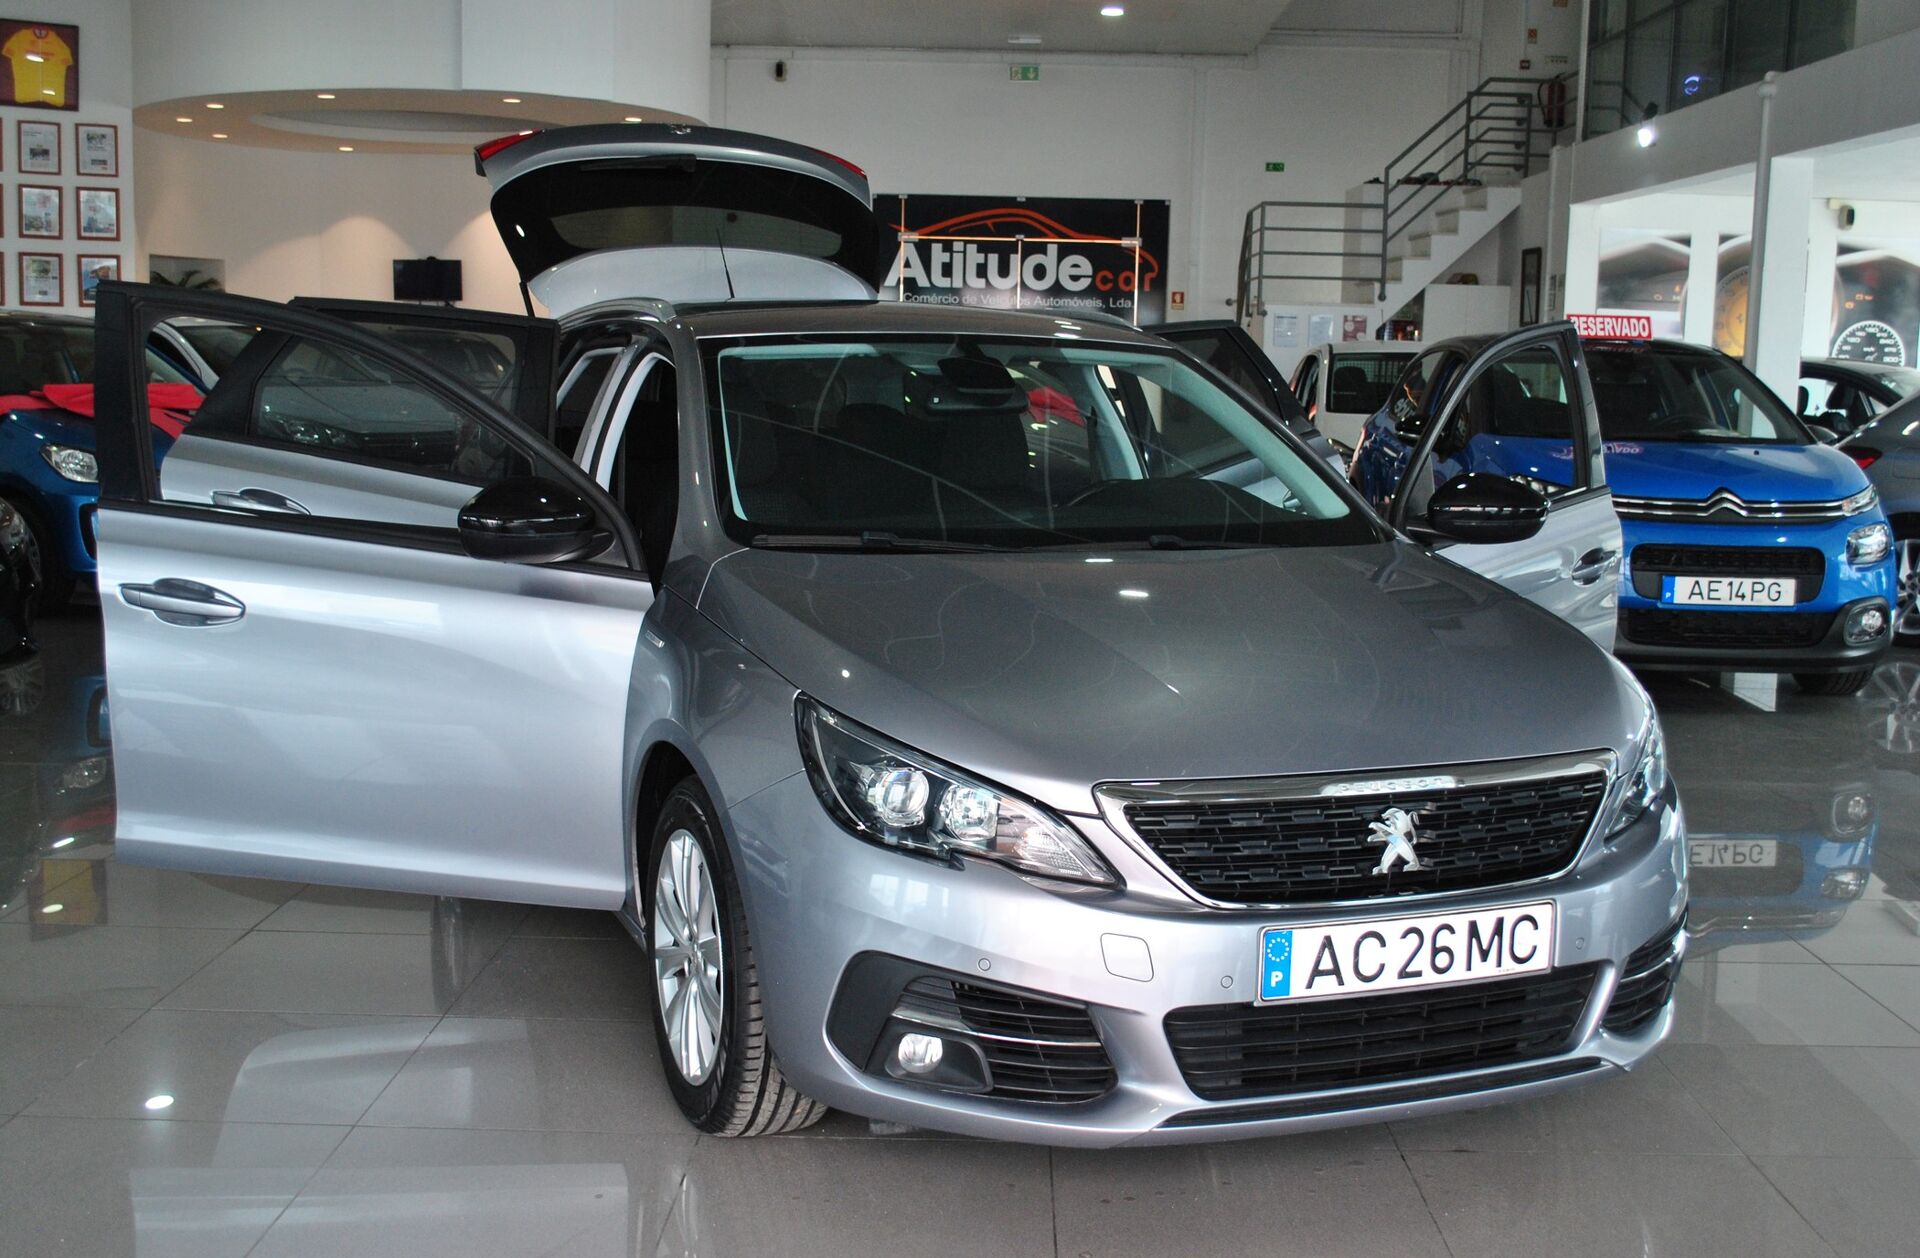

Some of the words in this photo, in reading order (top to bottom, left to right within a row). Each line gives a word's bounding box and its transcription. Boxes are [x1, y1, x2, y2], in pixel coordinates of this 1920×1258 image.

[883, 241, 1094, 292] Atitude
[1095, 270, 1158, 292] car
[903, 292, 960, 305] Comércio
[962, 294, 978, 305] de
[1033, 296, 1106, 309] Automóveis,
[1570, 316, 1649, 337] RESERVADO
[1688, 580, 1782, 602] AE14PG
[1270, 971, 1283, 987] P
[1305, 913, 1539, 990] AC26MC
